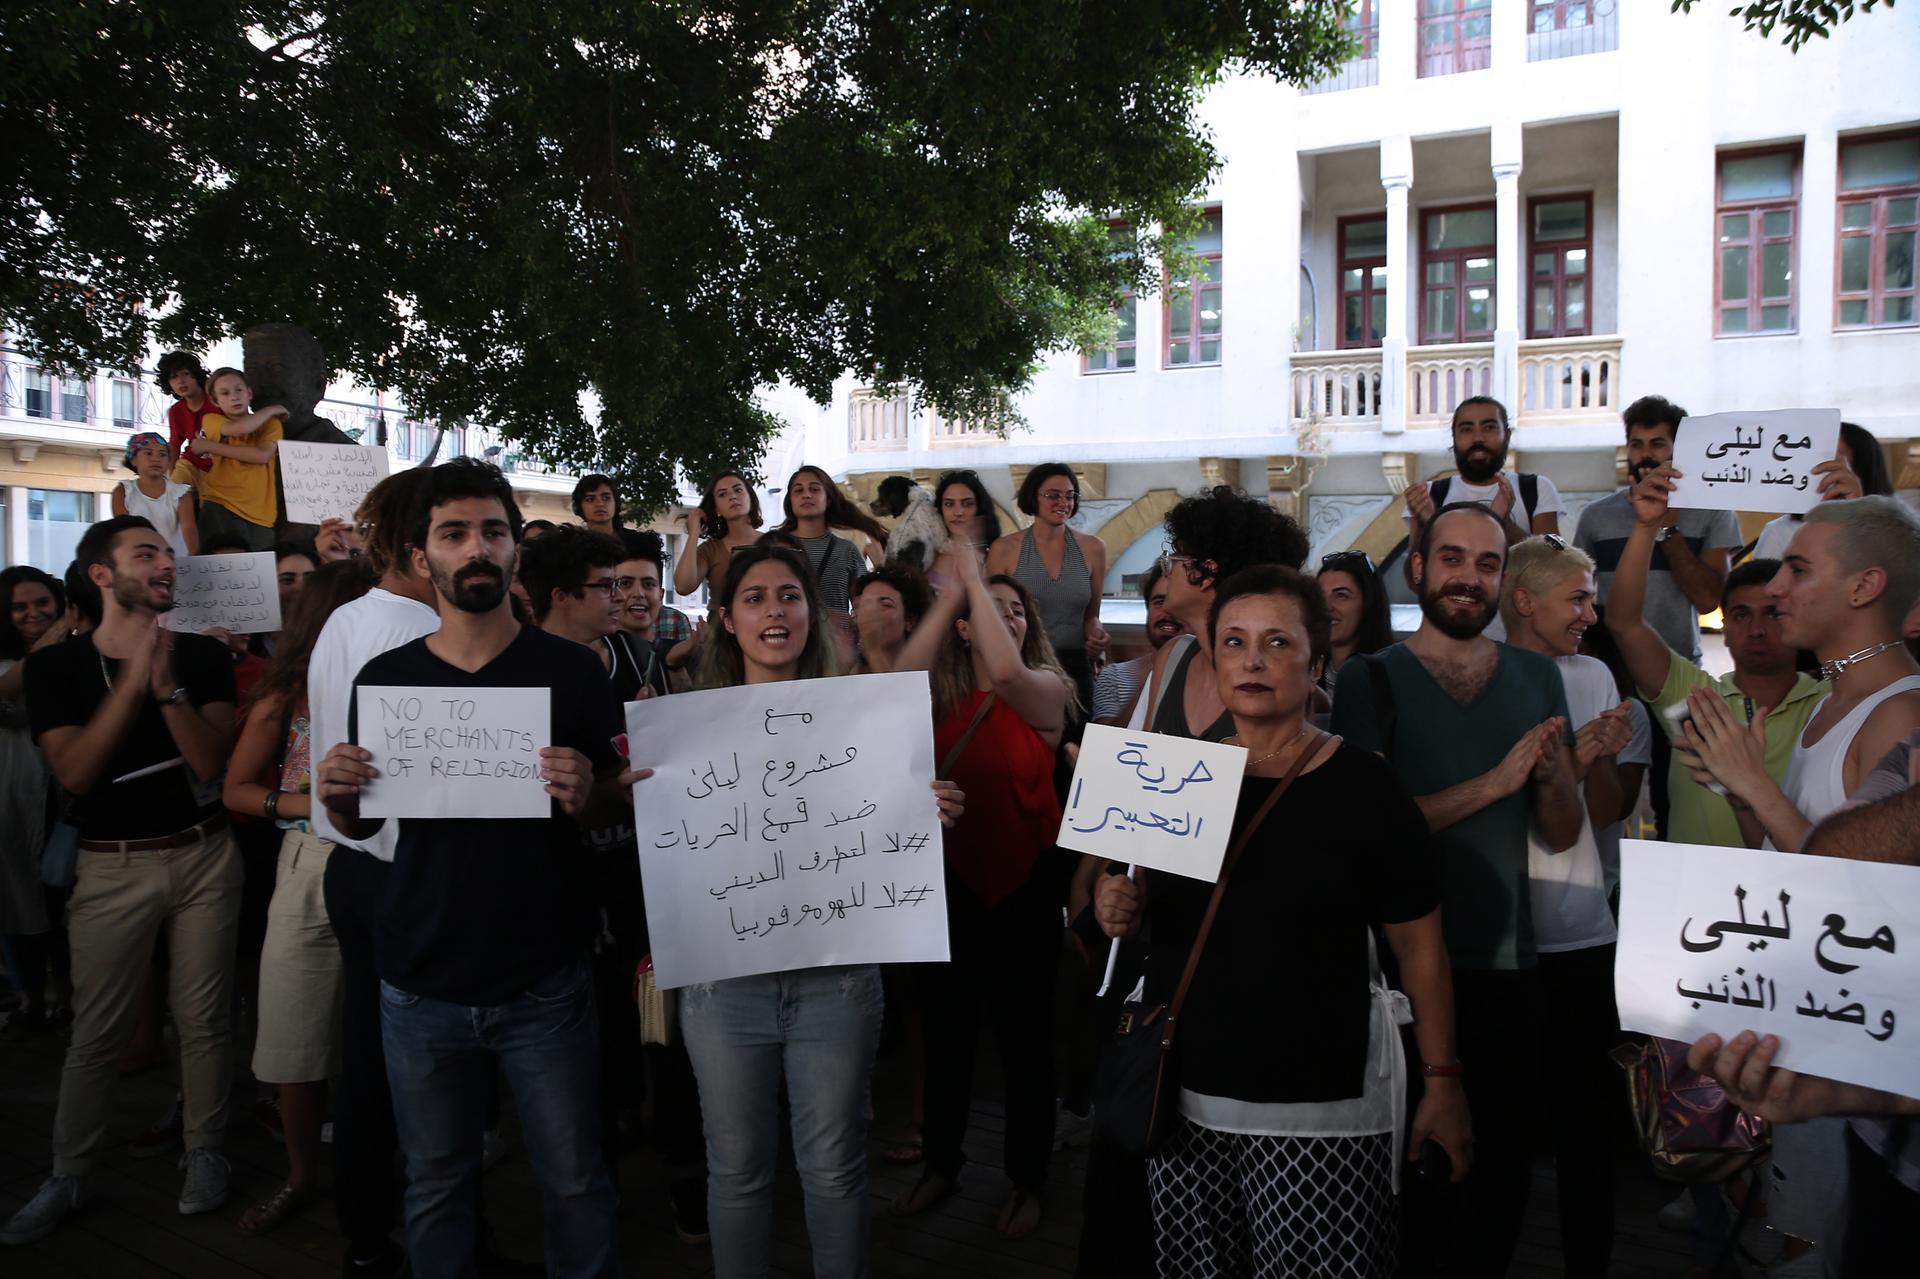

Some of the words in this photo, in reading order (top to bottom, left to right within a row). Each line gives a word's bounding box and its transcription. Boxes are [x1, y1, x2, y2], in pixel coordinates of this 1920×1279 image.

[1705, 426, 1764, 459] ليلى
[1772, 434, 1812, 462] مع
[1701, 463, 1751, 488] الذئب
[1760, 467, 1809, 491] وضد
[379, 697, 422, 721] NO
[440, 699, 476, 721] TO
[765, 709, 812, 735] مع
[384, 726, 535, 753] MERCHANTS
[386, 756, 414, 779] OF
[762, 746, 857, 798] مشروع
[1116, 742, 1214, 794] حرية
[654, 802, 748, 850] الحريات
[761, 797, 809, 842] قمع
[823, 799, 877, 828] ضد
[709, 850, 785, 900] الديني
[799, 831, 866, 875] لتطرف
[1680, 884, 1791, 953] ليلى
[1815, 913, 1896, 975] مع
[1676, 966, 1777, 1012] الذئب
[1796, 988, 1896, 1043] وضد
